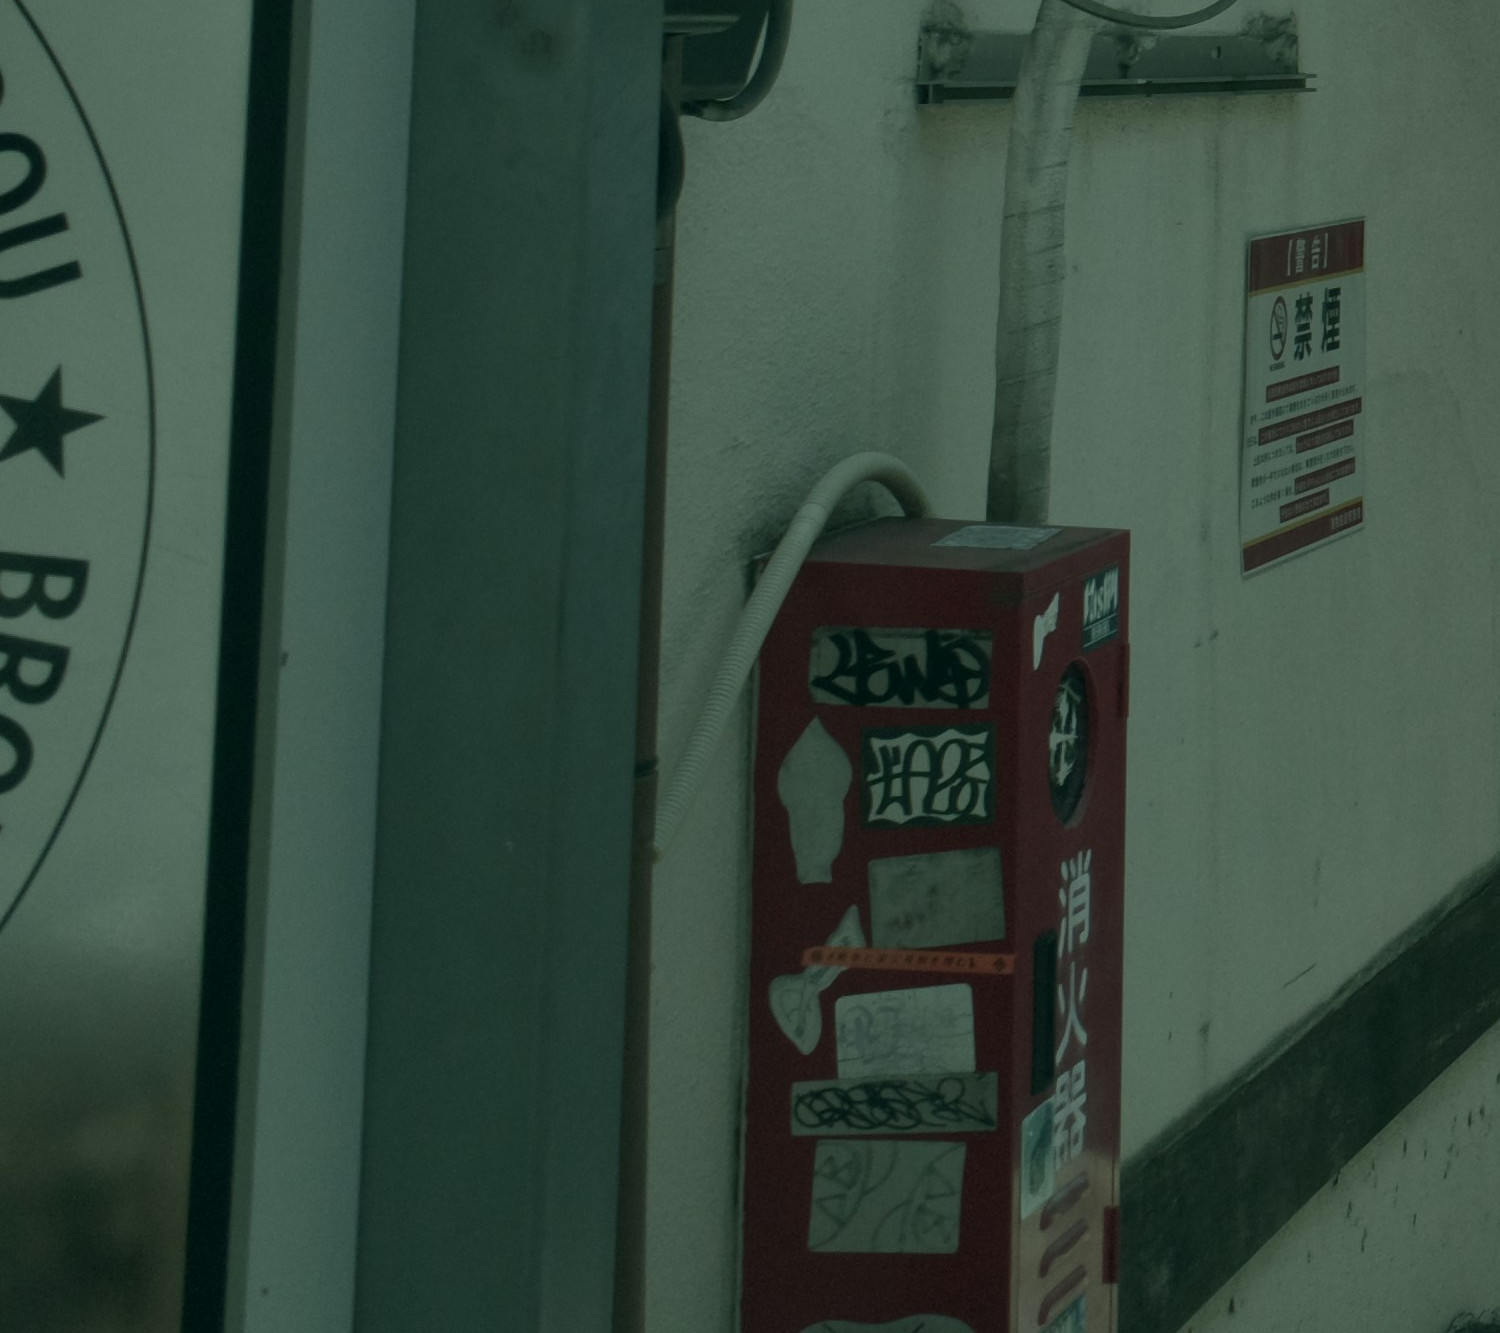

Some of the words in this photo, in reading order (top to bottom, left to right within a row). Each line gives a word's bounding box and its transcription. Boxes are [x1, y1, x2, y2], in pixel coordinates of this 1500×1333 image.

[1294, 286, 1341, 361] 禁煙
[1056, 848, 1092, 1173] 消火器
